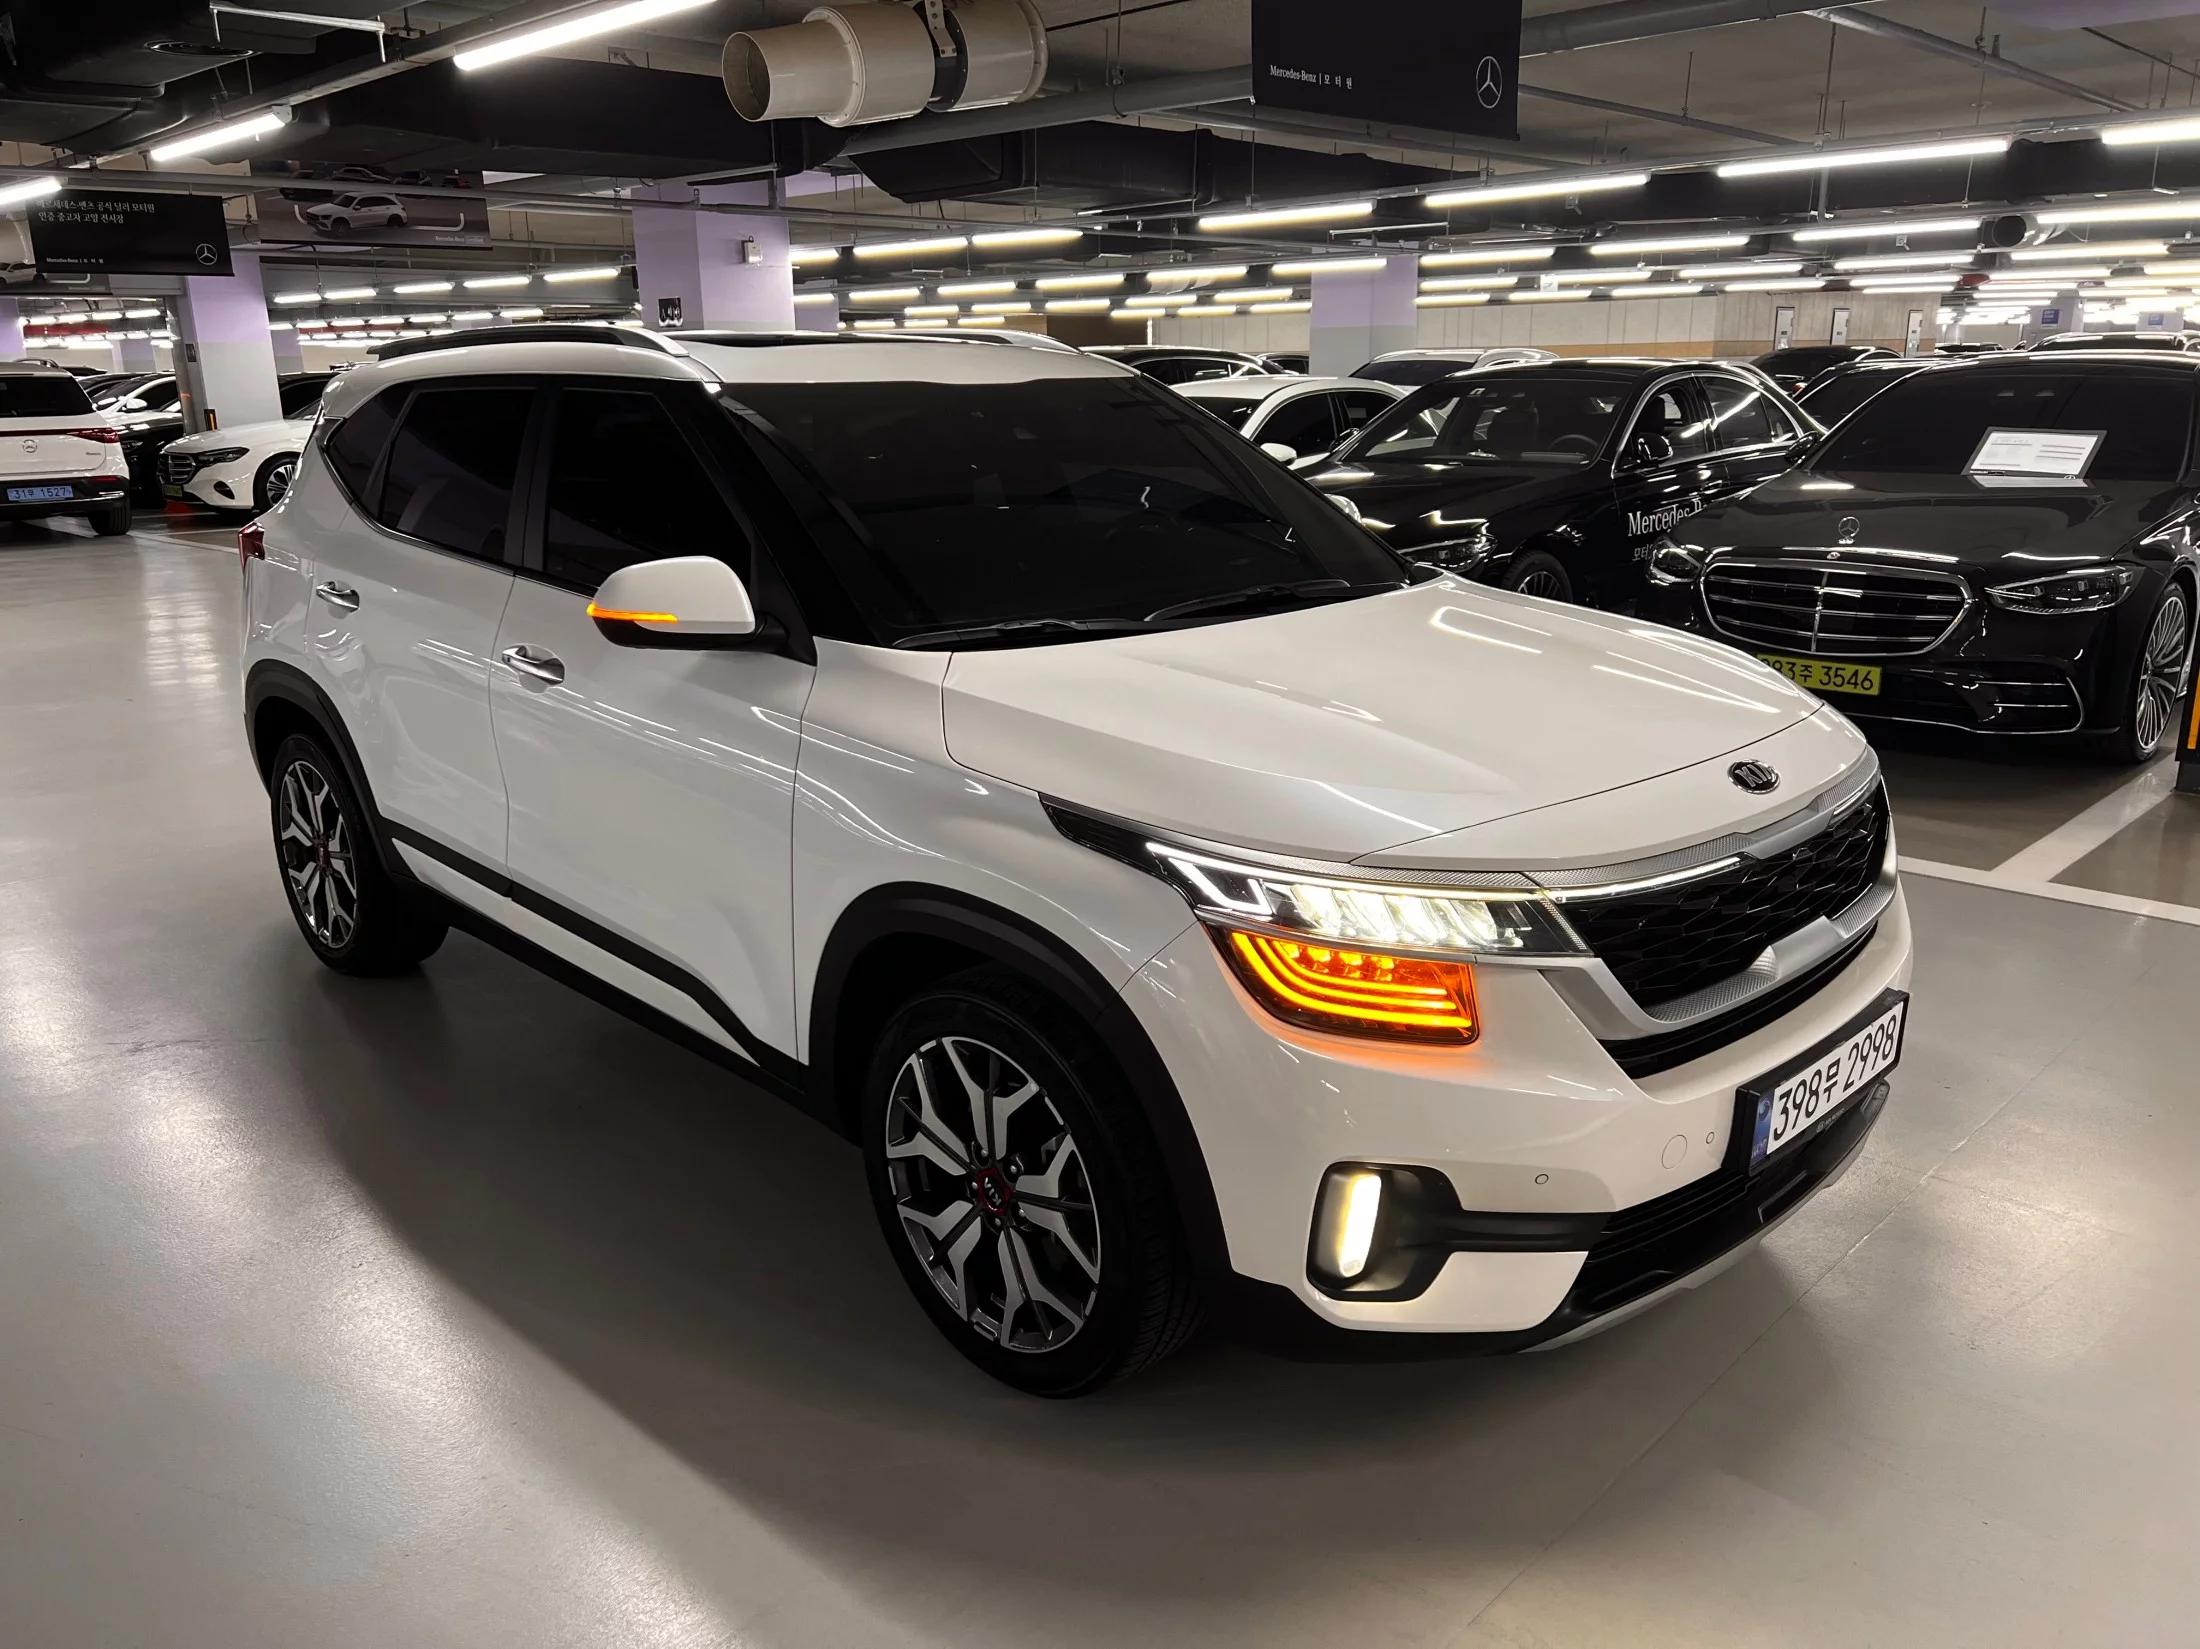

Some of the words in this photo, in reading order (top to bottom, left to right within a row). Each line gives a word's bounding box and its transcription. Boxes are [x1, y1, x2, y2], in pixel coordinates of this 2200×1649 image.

[1270, 64, 1317, 83] Mercedes-Benz
[40, 487, 66, 497] 1527
[1819, 665, 1874, 691] 3546
[1773, 1056, 1842, 1141] 398무
[1843, 1014, 1898, 1093] 2998
